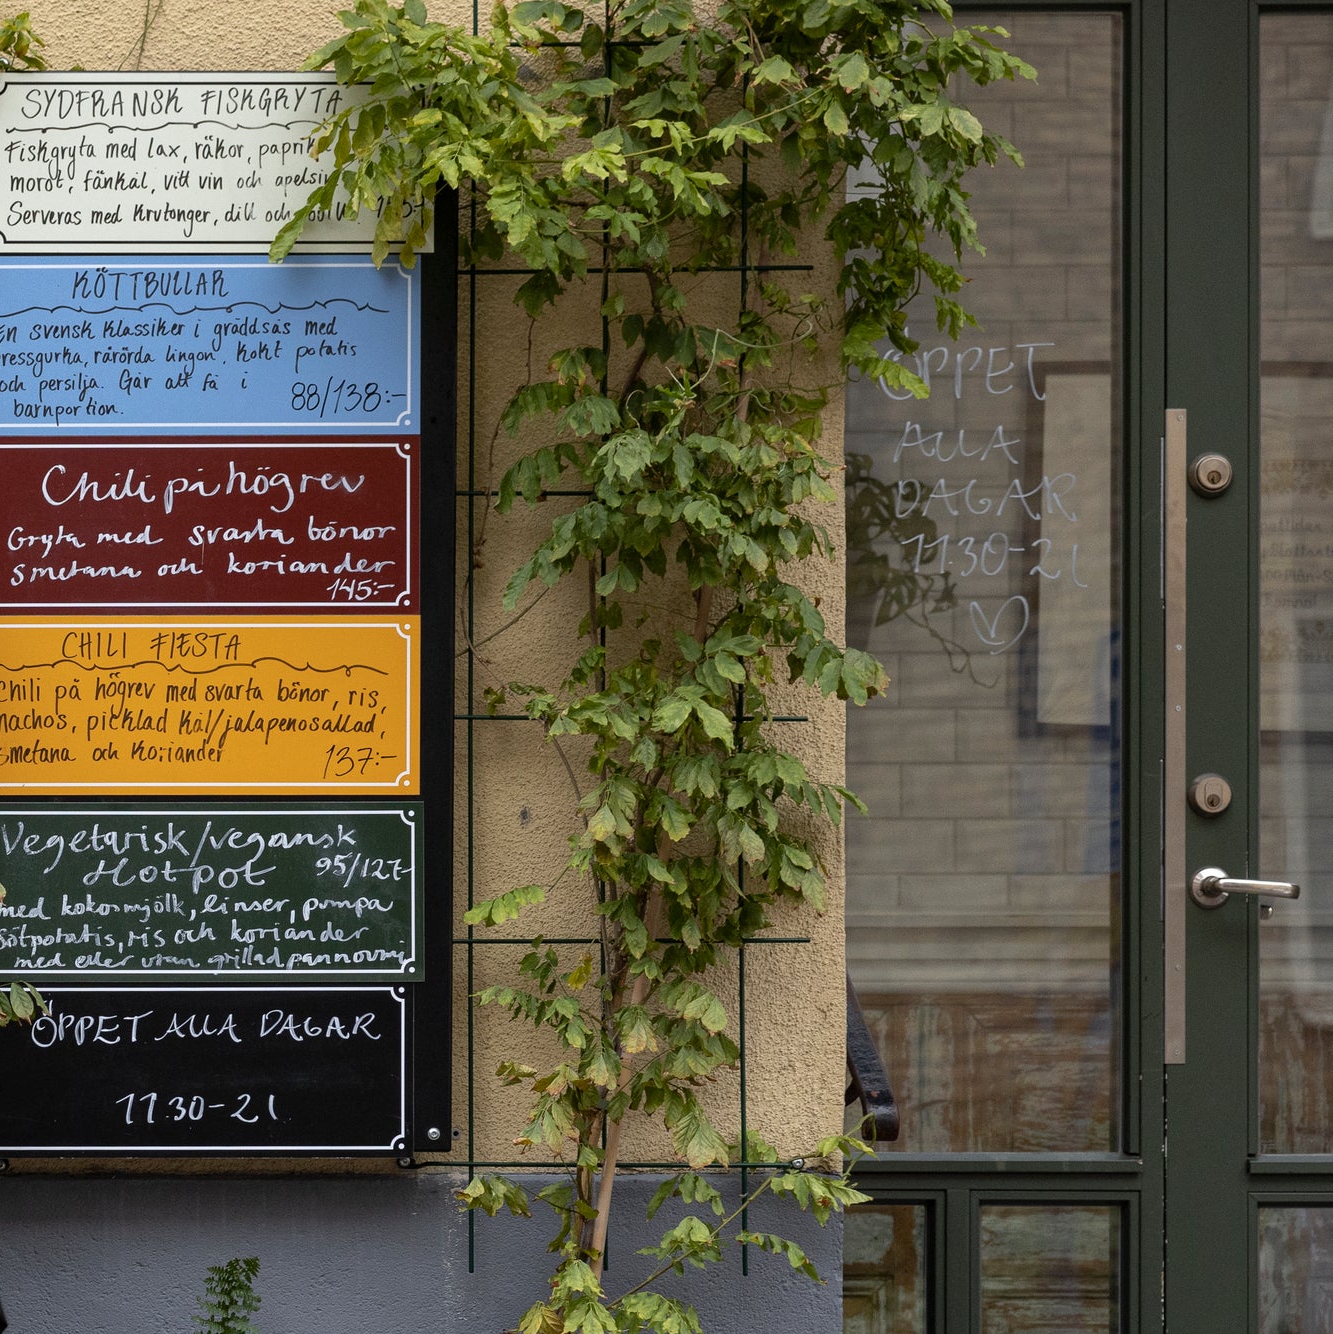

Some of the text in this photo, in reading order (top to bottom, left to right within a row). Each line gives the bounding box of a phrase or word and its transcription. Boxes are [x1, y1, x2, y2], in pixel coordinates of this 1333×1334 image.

[21, 87, 343, 119] SYDFRANSK FISKGRYTA
[4, 135, 97, 180] Fiskgryta
[105, 137, 137, 161] med
[147, 137, 188, 163] lax,
[195, 134, 252, 164] räkor,
[164, 169, 190, 190] vitt
[199, 170, 223, 190] vin
[237, 170, 263, 189] och
[6, 200, 82, 226] Serveras
[91, 204, 123, 224] med
[225, 203, 256, 222] dill
[265, 203, 291, 222] och
[72, 266, 229, 300] KÖTTBULLAR
[29, 320, 96, 341] svensk
[194, 319, 201, 338] i
[212, 317, 291, 351] gräddsås
[305, 316, 338, 336] med
[94, 345, 155, 364] rårörda
[295, 339, 358, 374] potatis
[39, 372, 105, 402] persilja.
[118, 368, 153, 396] Går
[165, 371, 192, 390] att
[202, 372, 219, 391] få
[241, 371, 248, 390] i
[893, 420, 1021, 465] ALLA
[41, 460, 366, 514] Chili på högrev
[894, 473, 1078, 521] DAGAR
[7, 515, 397, 559] Gryta med svarta bönor
[158, 558, 203, 576] och
[227, 552, 396, 575] koriander
[62, 631, 241, 661] CHILI FIESTA
[55, 678, 82, 715] på
[94, 671, 156, 718] högrev
[166, 677, 198, 703] med
[204, 677, 263, 701] svarta
[92, 741, 120, 761] och
[174, 921, 216, 945] och
[230, 918, 369, 943] koriander
[13, 952, 66, 968] med
[31, 1000, 382, 1048] ÖPPET ALLA DAGAR
